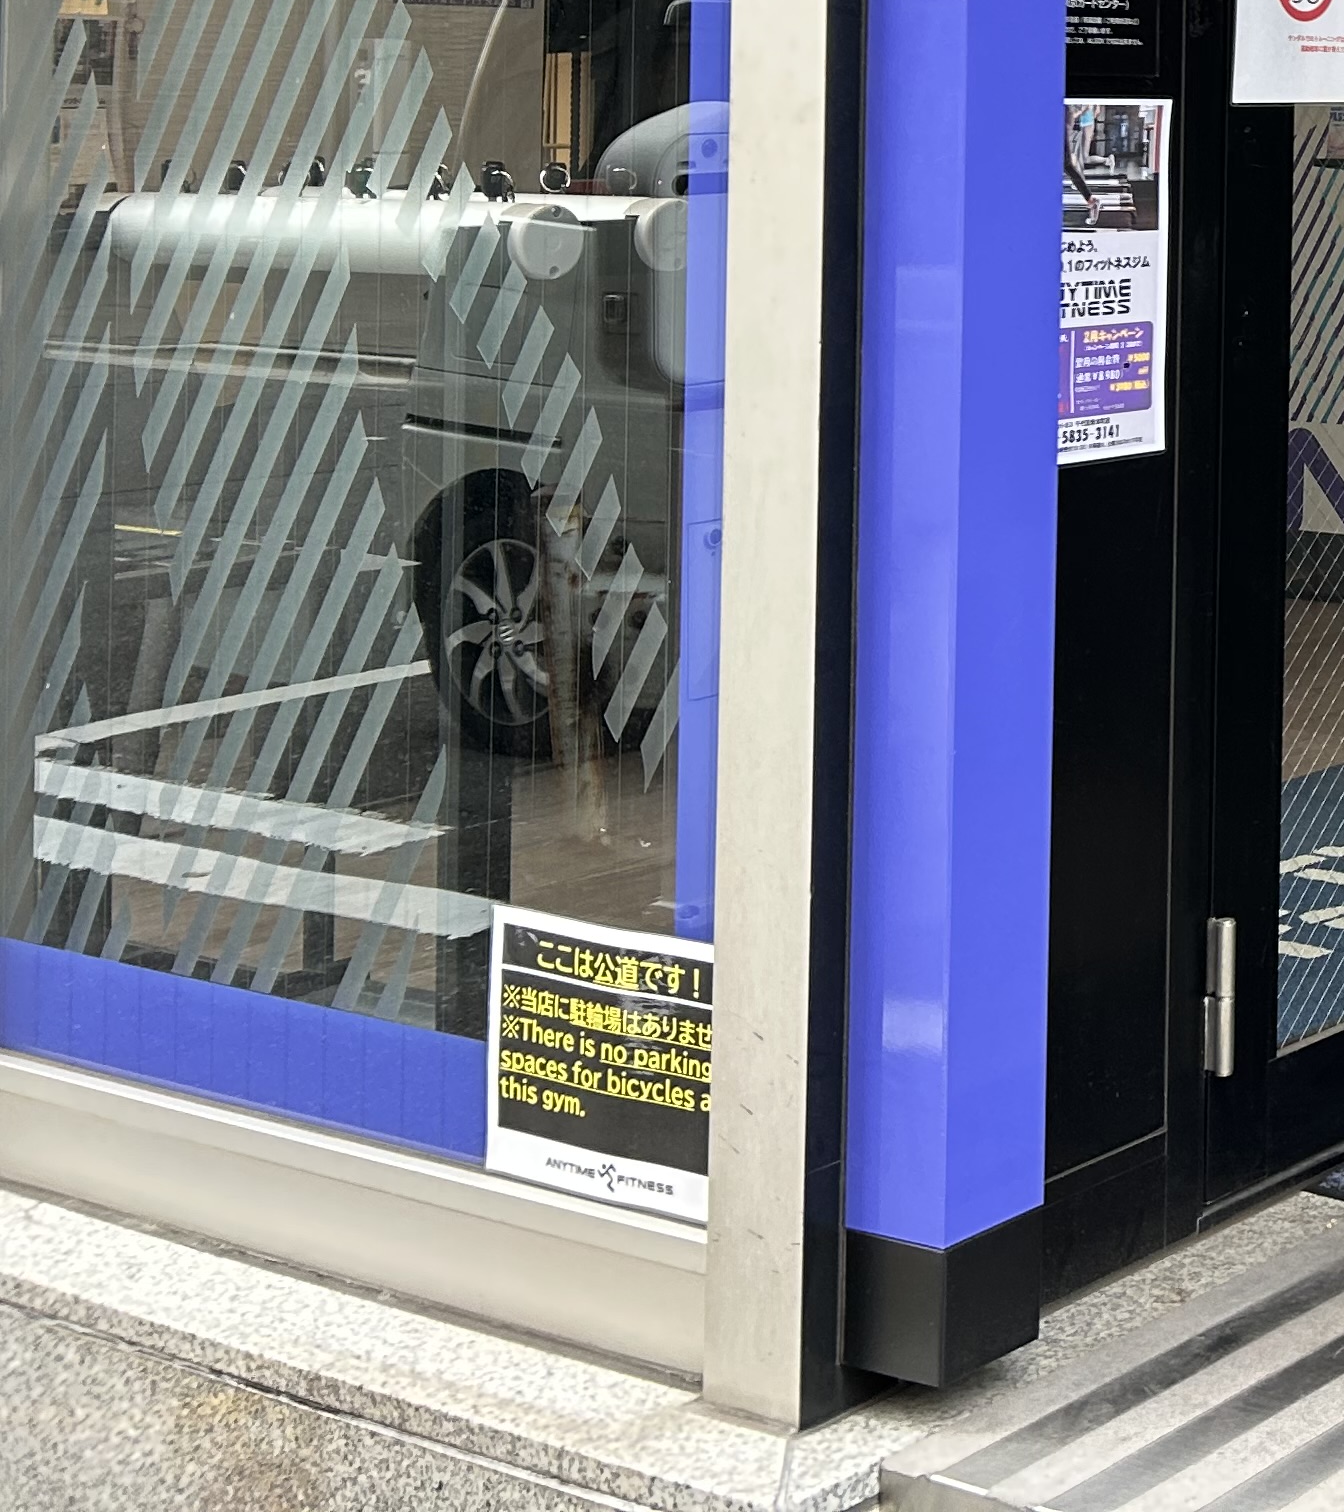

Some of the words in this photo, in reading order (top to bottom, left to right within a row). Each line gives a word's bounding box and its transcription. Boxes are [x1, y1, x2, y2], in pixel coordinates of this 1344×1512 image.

[536, 940, 700, 999] ここは公道です！
[500, 1049, 568, 1082] spaces
[572, 1063, 603, 1089] for
[607, 1068, 696, 1110] bicycles
[579, 1030, 596, 1058] is
[600, 1041, 628, 1065] no
[633, 1044, 712, 1080] parking
[500, 1076, 538, 1104] this
[542, 1090, 587, 1118] gym.
[545, 1156, 596, 1179] ANYTIME
[616, 1175, 675, 1196] FITNESS
